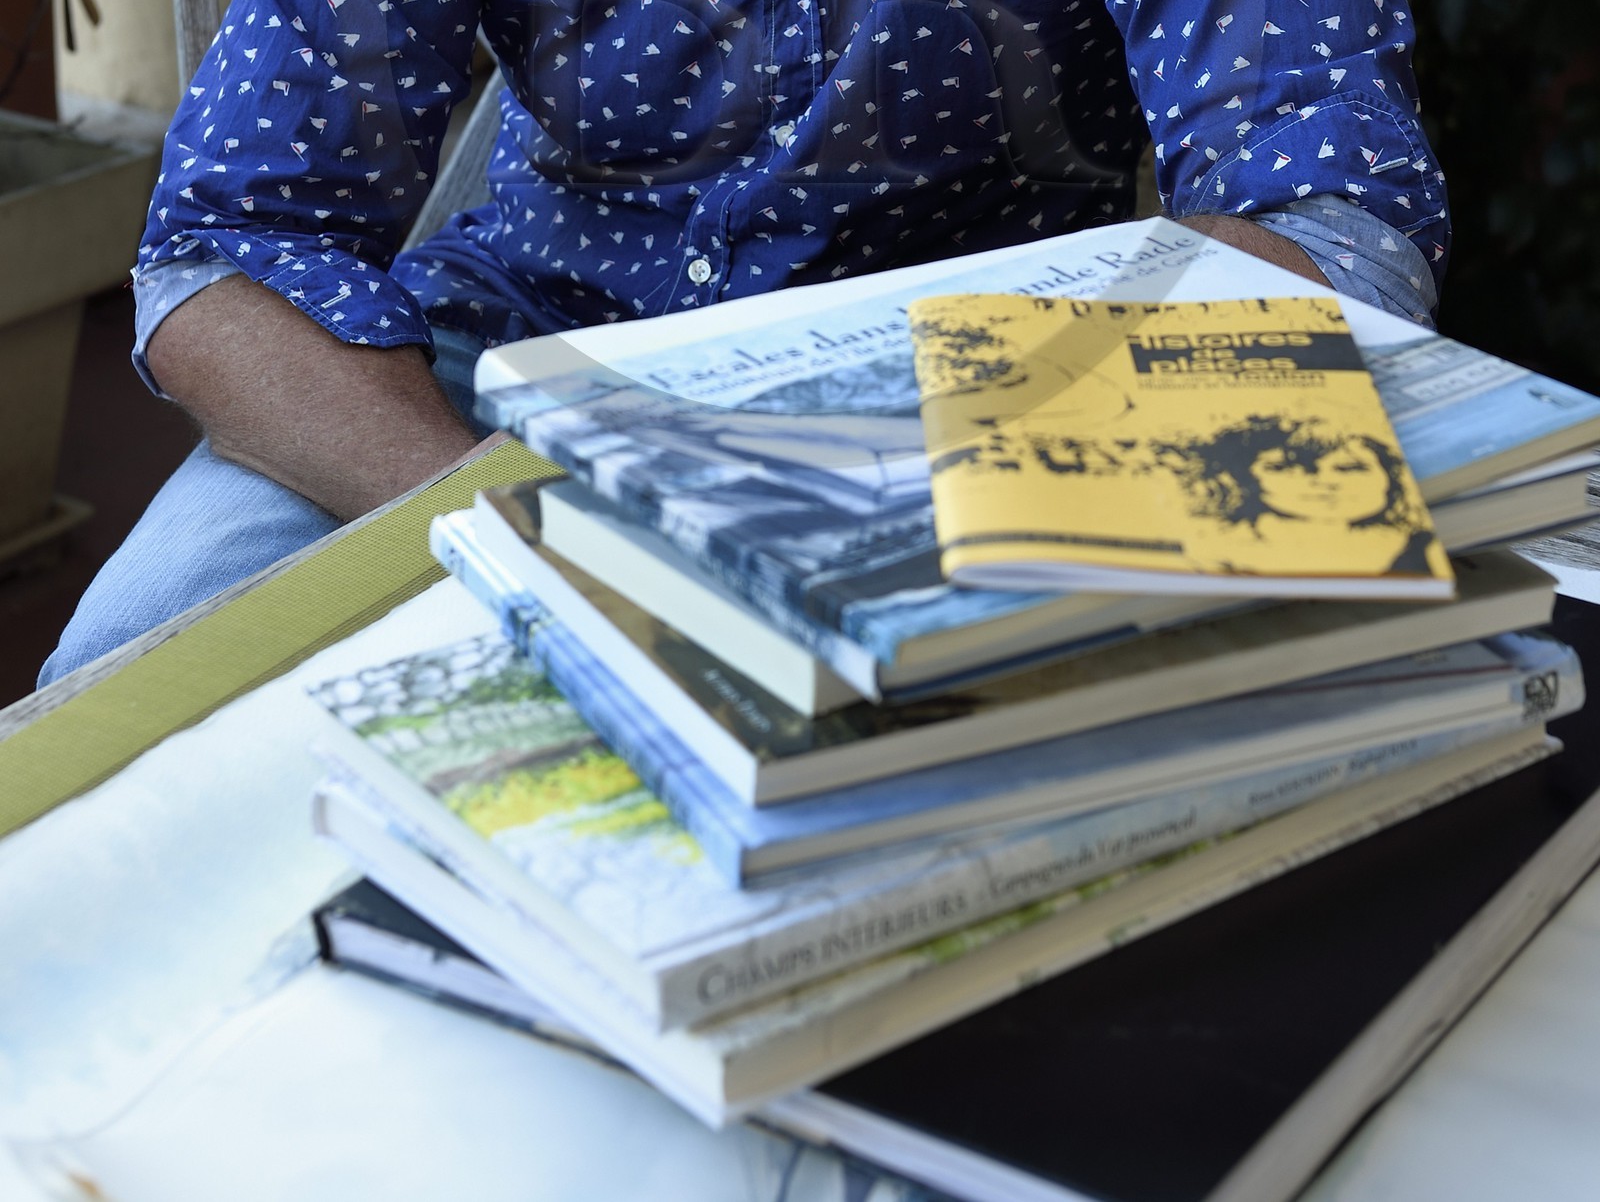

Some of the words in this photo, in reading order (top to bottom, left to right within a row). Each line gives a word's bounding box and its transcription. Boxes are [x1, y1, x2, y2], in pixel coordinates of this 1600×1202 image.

[648, 347, 805, 389] Escales
[808, 320, 906, 351] dans
[1008, 264, 1099, 297] ande
[1094, 235, 1198, 270] Rade
[1191, 347, 1245, 361] de
[1150, 356, 1298, 378] places
